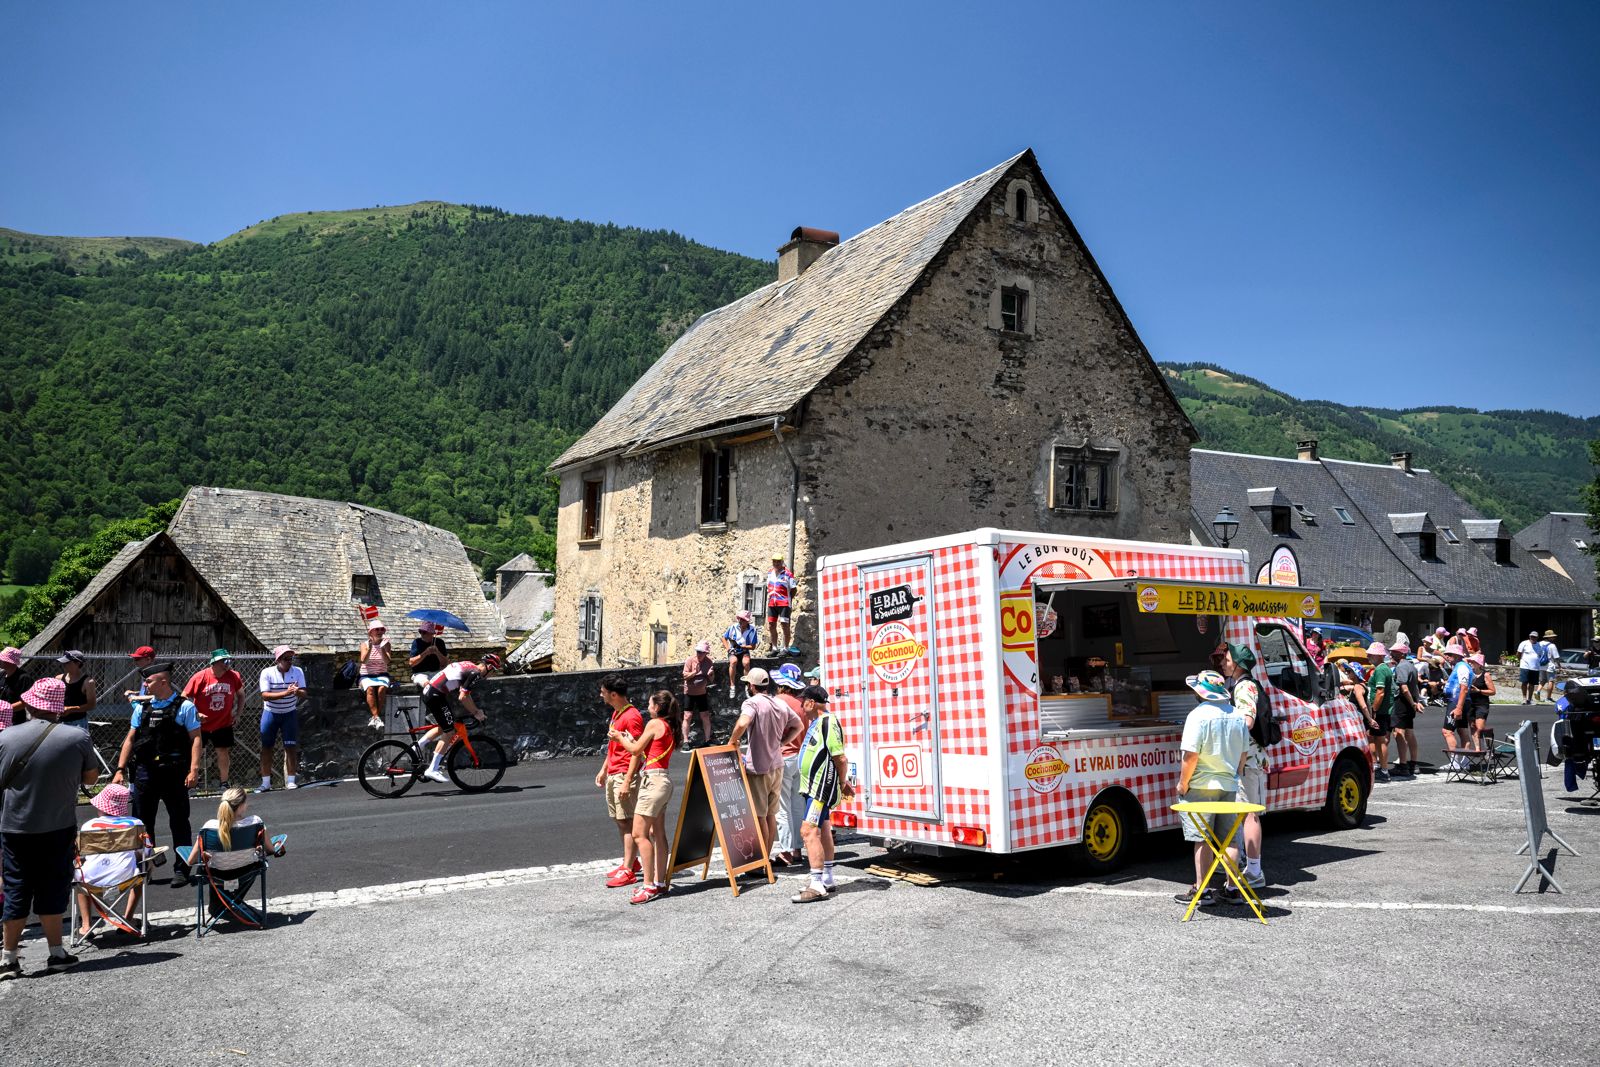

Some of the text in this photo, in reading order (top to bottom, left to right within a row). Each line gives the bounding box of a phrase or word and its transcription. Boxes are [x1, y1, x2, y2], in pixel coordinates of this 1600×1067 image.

[1018, 552, 1032, 570] LE
[1035, 545, 1058, 558] BON
[873, 591, 907, 609] LE BAR
[1178, 590, 1289, 614] LE BAR à Saucisson
[879, 604, 911, 619] Saucisson
[873, 645, 915, 662] Cochonou
[1074, 757, 1087, 773] LE
[1089, 755, 1114, 772] VRAI
[1117, 753, 1138, 769] BON
[1140, 748, 1167, 767] GOÛT
[1027, 763, 1062, 777] Cochonou
